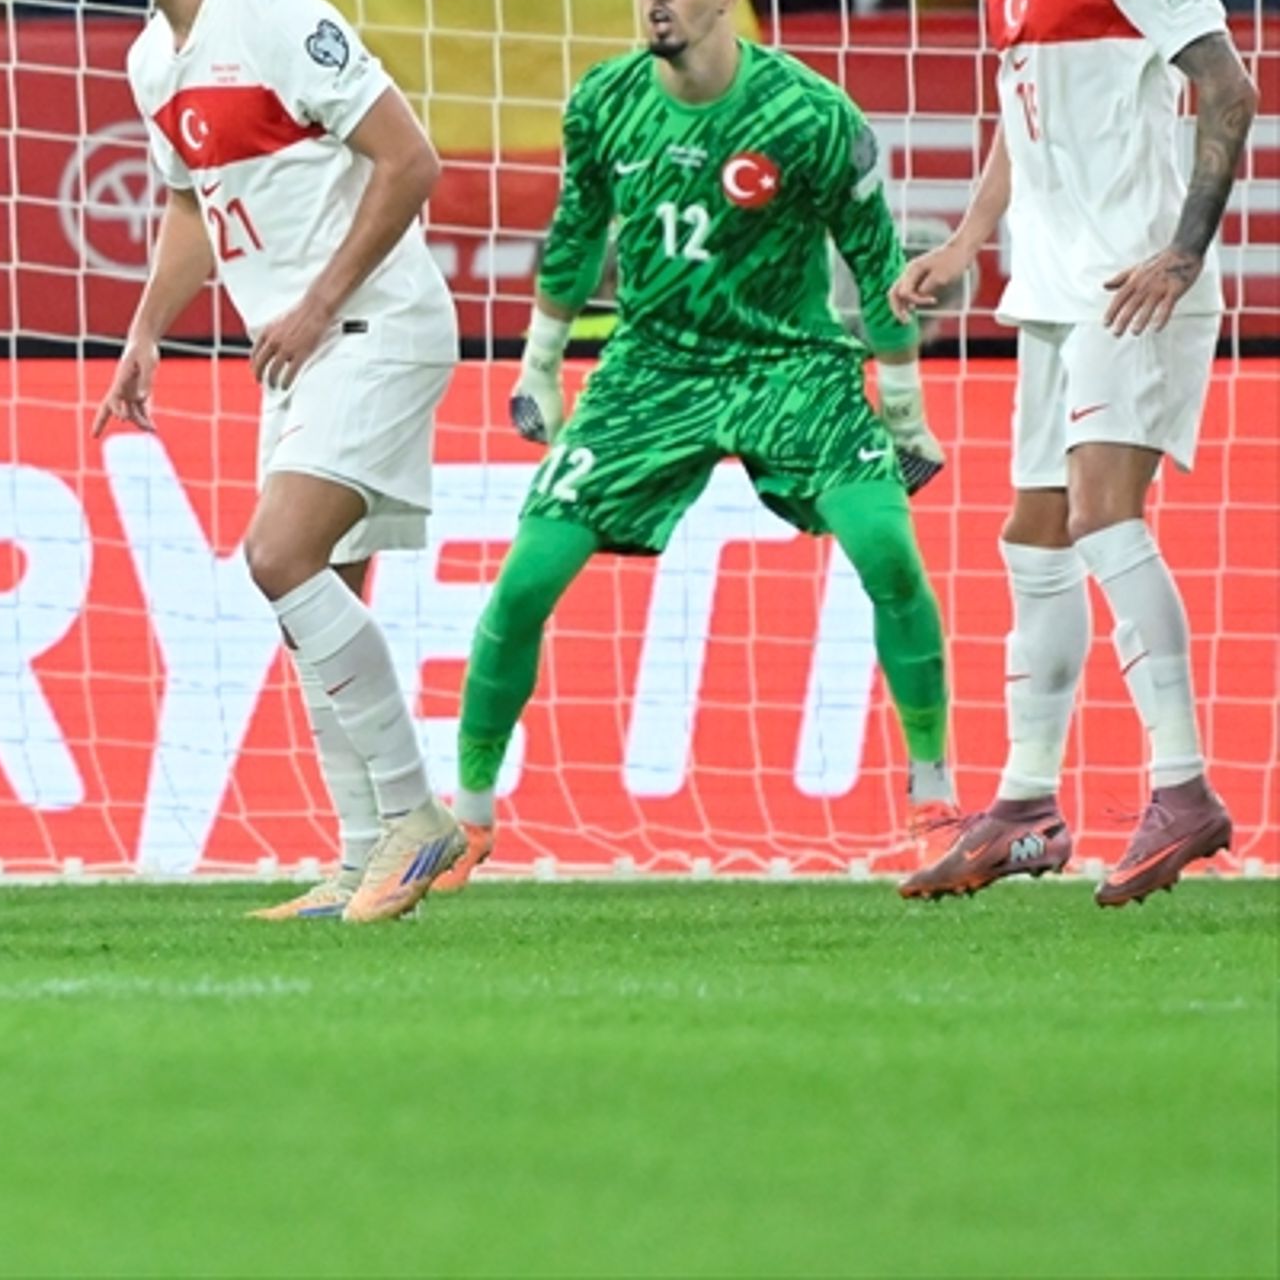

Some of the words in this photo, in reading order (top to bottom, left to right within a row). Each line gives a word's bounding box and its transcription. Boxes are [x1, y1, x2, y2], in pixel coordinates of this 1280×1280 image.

[208, 197, 264, 263] 21
[656, 201, 711, 261] 12
[537, 443, 597, 503] 12
